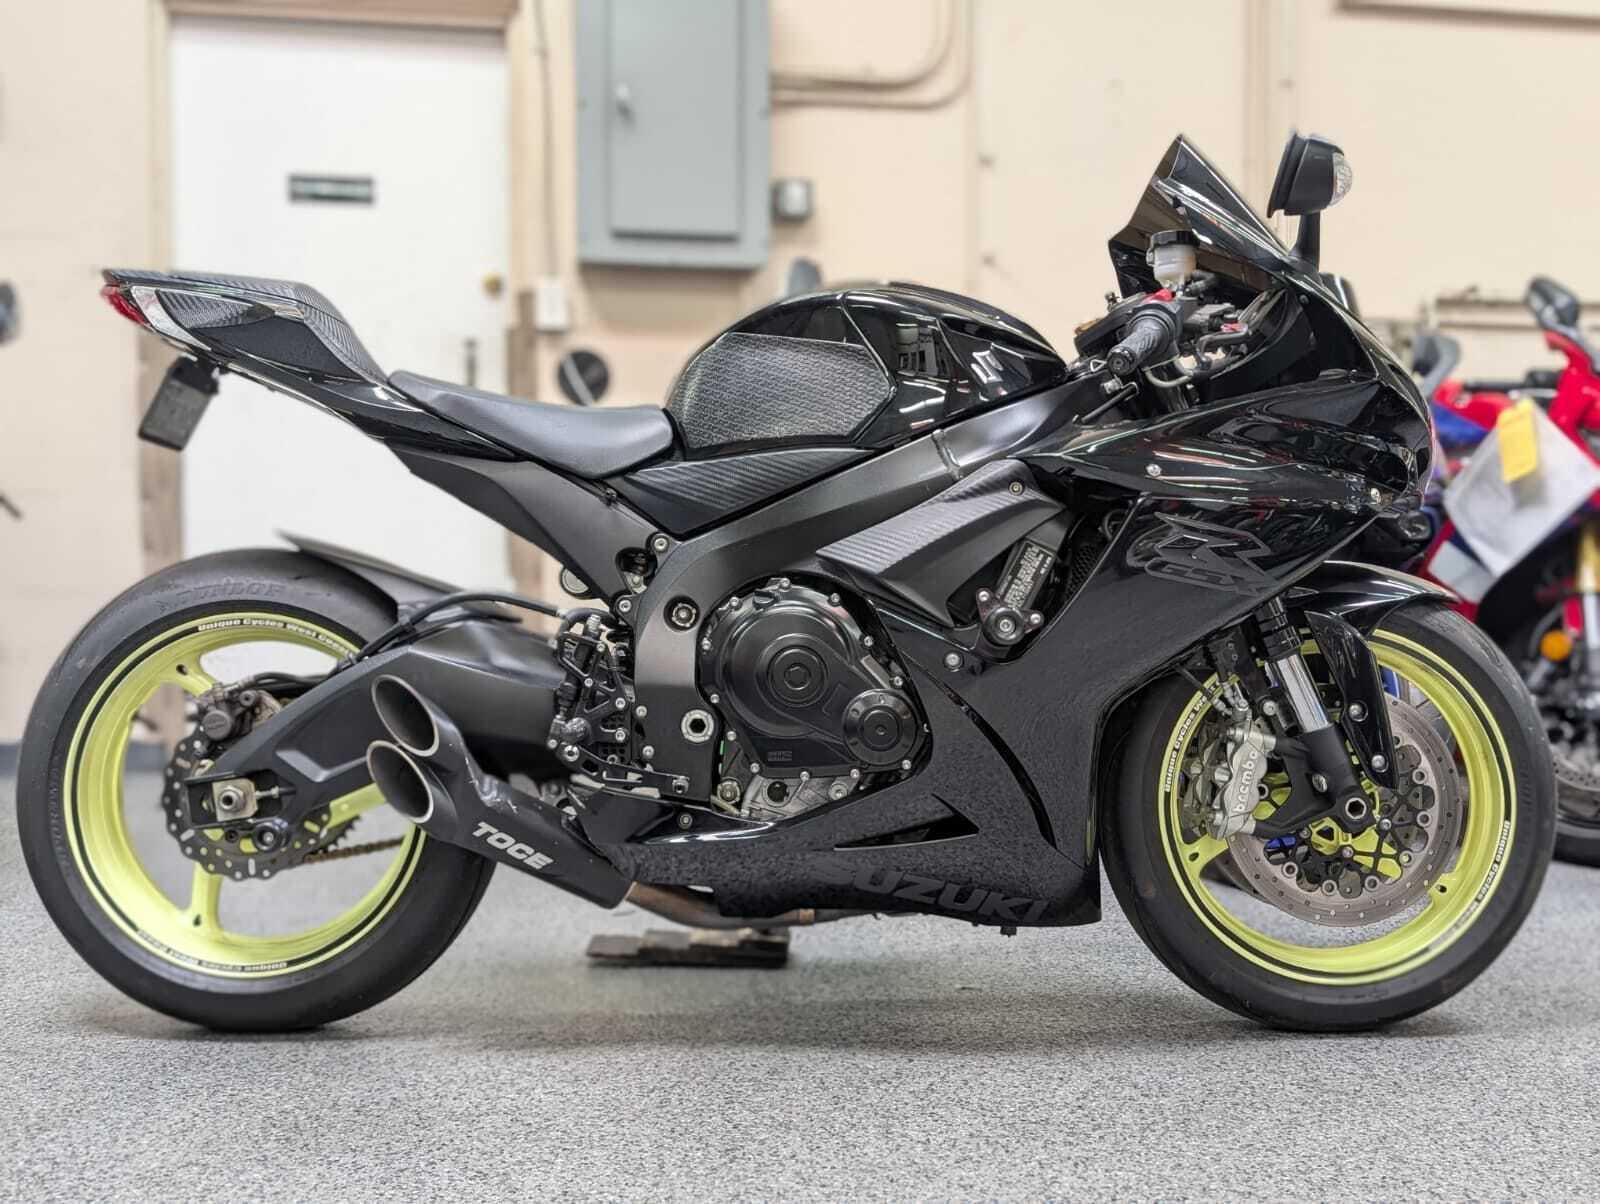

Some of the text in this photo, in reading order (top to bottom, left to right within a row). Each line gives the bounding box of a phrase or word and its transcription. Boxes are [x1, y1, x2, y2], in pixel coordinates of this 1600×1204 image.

[197, 618, 241, 632] Unique
[243, 618, 284, 628] Cycles
[286, 622, 316, 637] West
[1164, 750, 1177, 793] Unique
[1174, 712, 1196, 750] Cycles
[1233, 750, 1258, 812] brembo
[472, 821, 555, 870] TOCE
[1495, 819, 1511, 862] Unique
[808, 855, 1050, 923] SUZUKI
